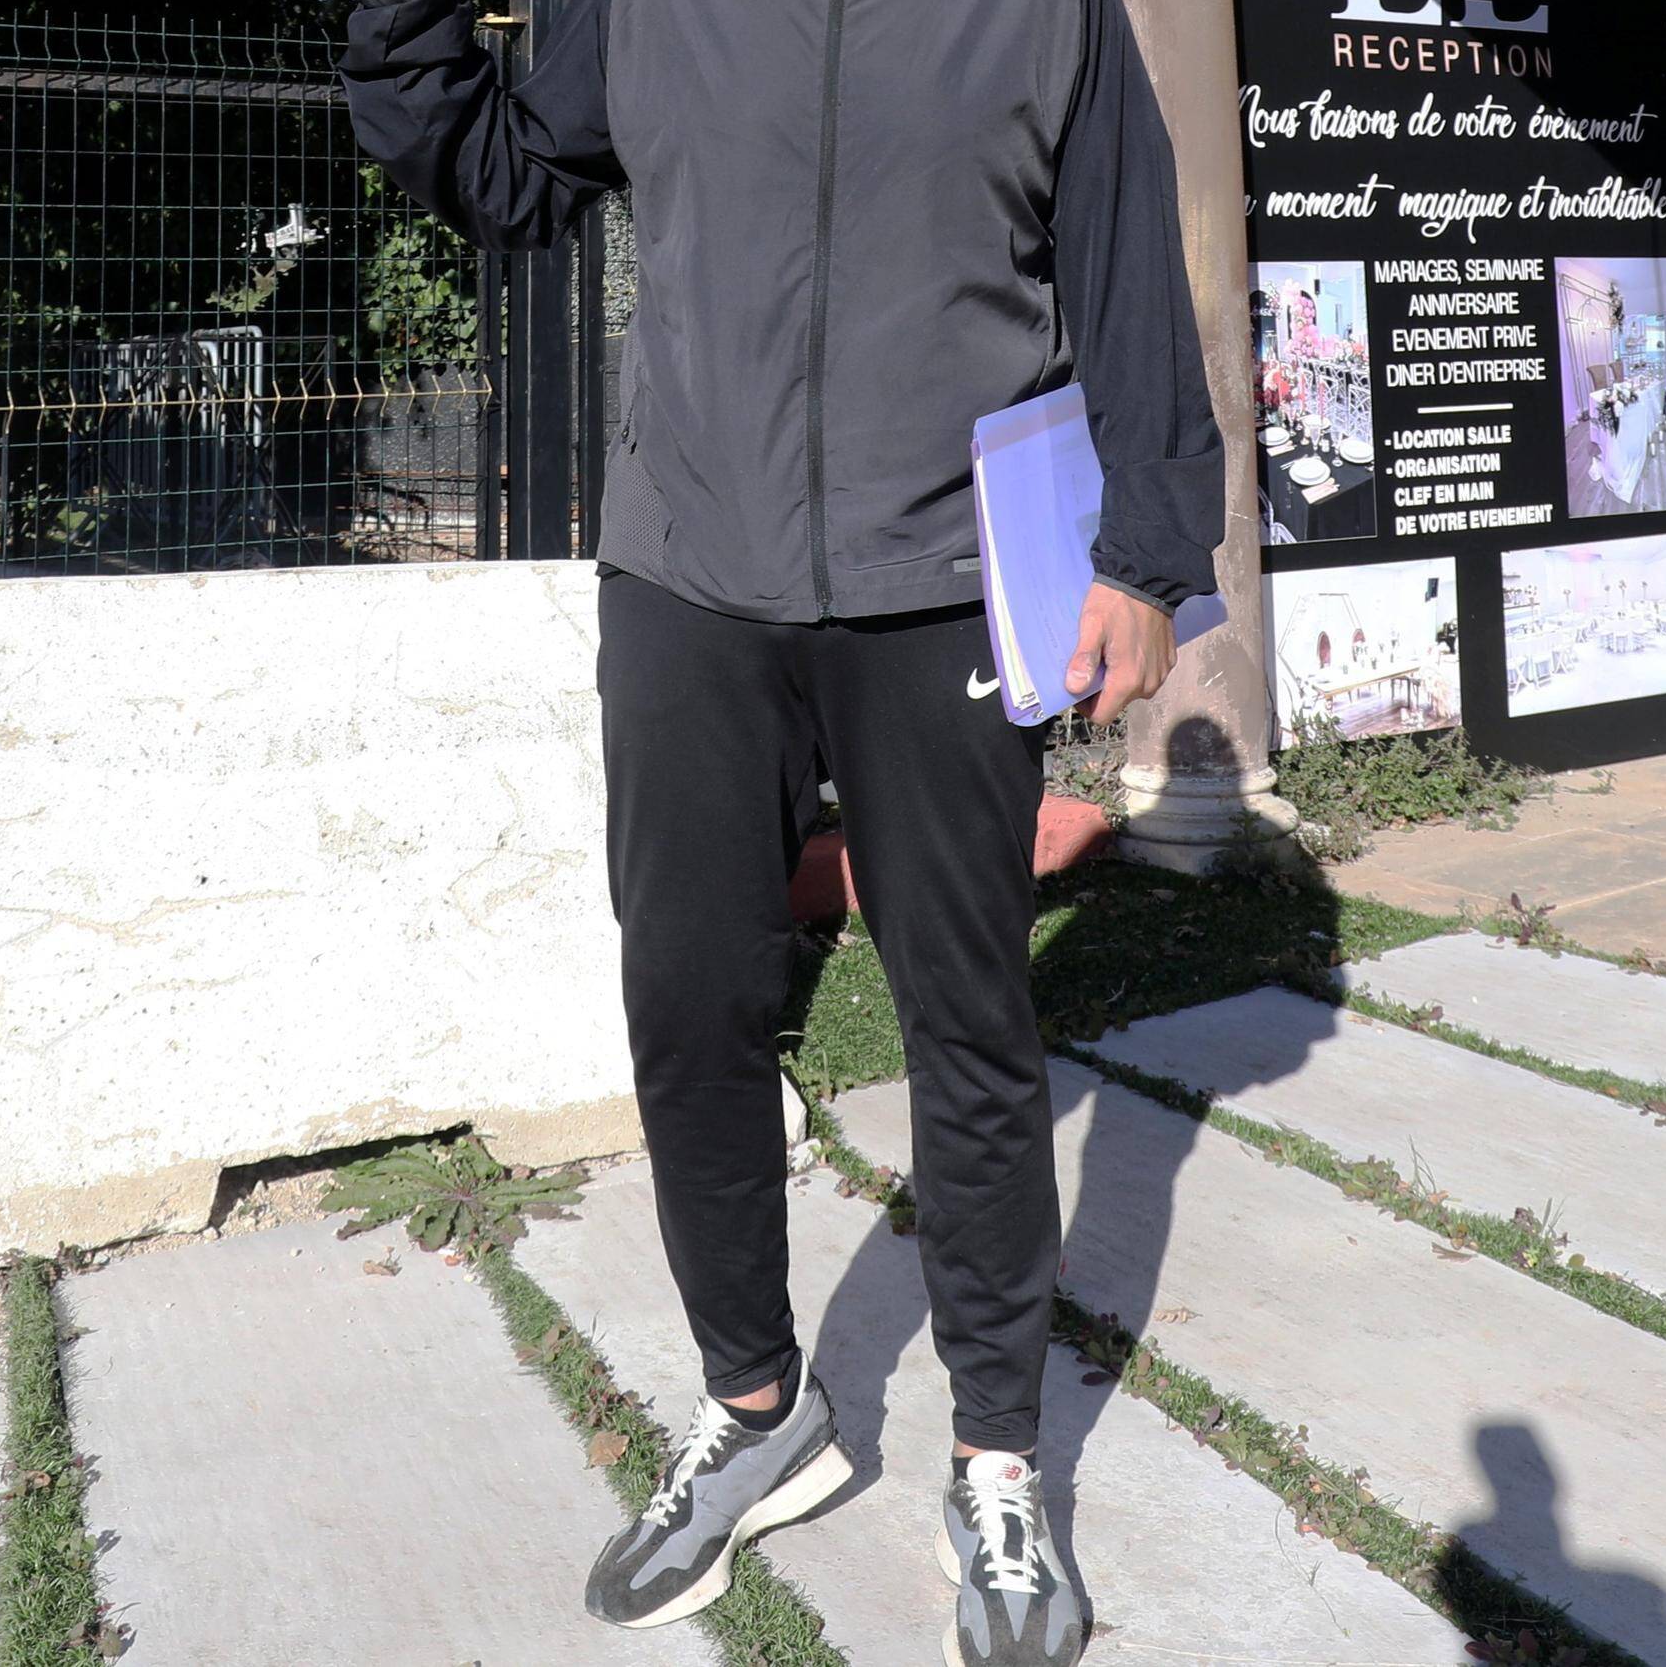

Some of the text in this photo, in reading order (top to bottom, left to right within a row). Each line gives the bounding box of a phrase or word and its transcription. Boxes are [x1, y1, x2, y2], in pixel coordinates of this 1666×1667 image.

[1333, 33, 1553, 78] RECEPTION
[1298, 89, 1400, 142] faisons
[1408, 92, 1446, 138] de
[1454, 94, 1517, 139] votre
[1528, 103, 1659, 143] évènement
[1266, 173, 1395, 220] moment
[1398, 187, 1513, 244] magique
[1519, 175, 1560, 219] et
[1374, 258, 1545, 285] MARIAGES, SEMINAIRE
[1408, 292, 1521, 317] ANNIVERSAIRE
[1392, 324, 1538, 352] EVENEMENT PRIVE
[1386, 358, 1547, 387] DINER D'ENTREPRISE
[1393, 424, 1513, 450] LOCATION SALLE
[1394, 452, 1502, 479] ORGANISATION
[1394, 480, 1495, 507] CLEF EN MAIN
[1395, 503, 1554, 536] DE VOTRE EVENEMENT
